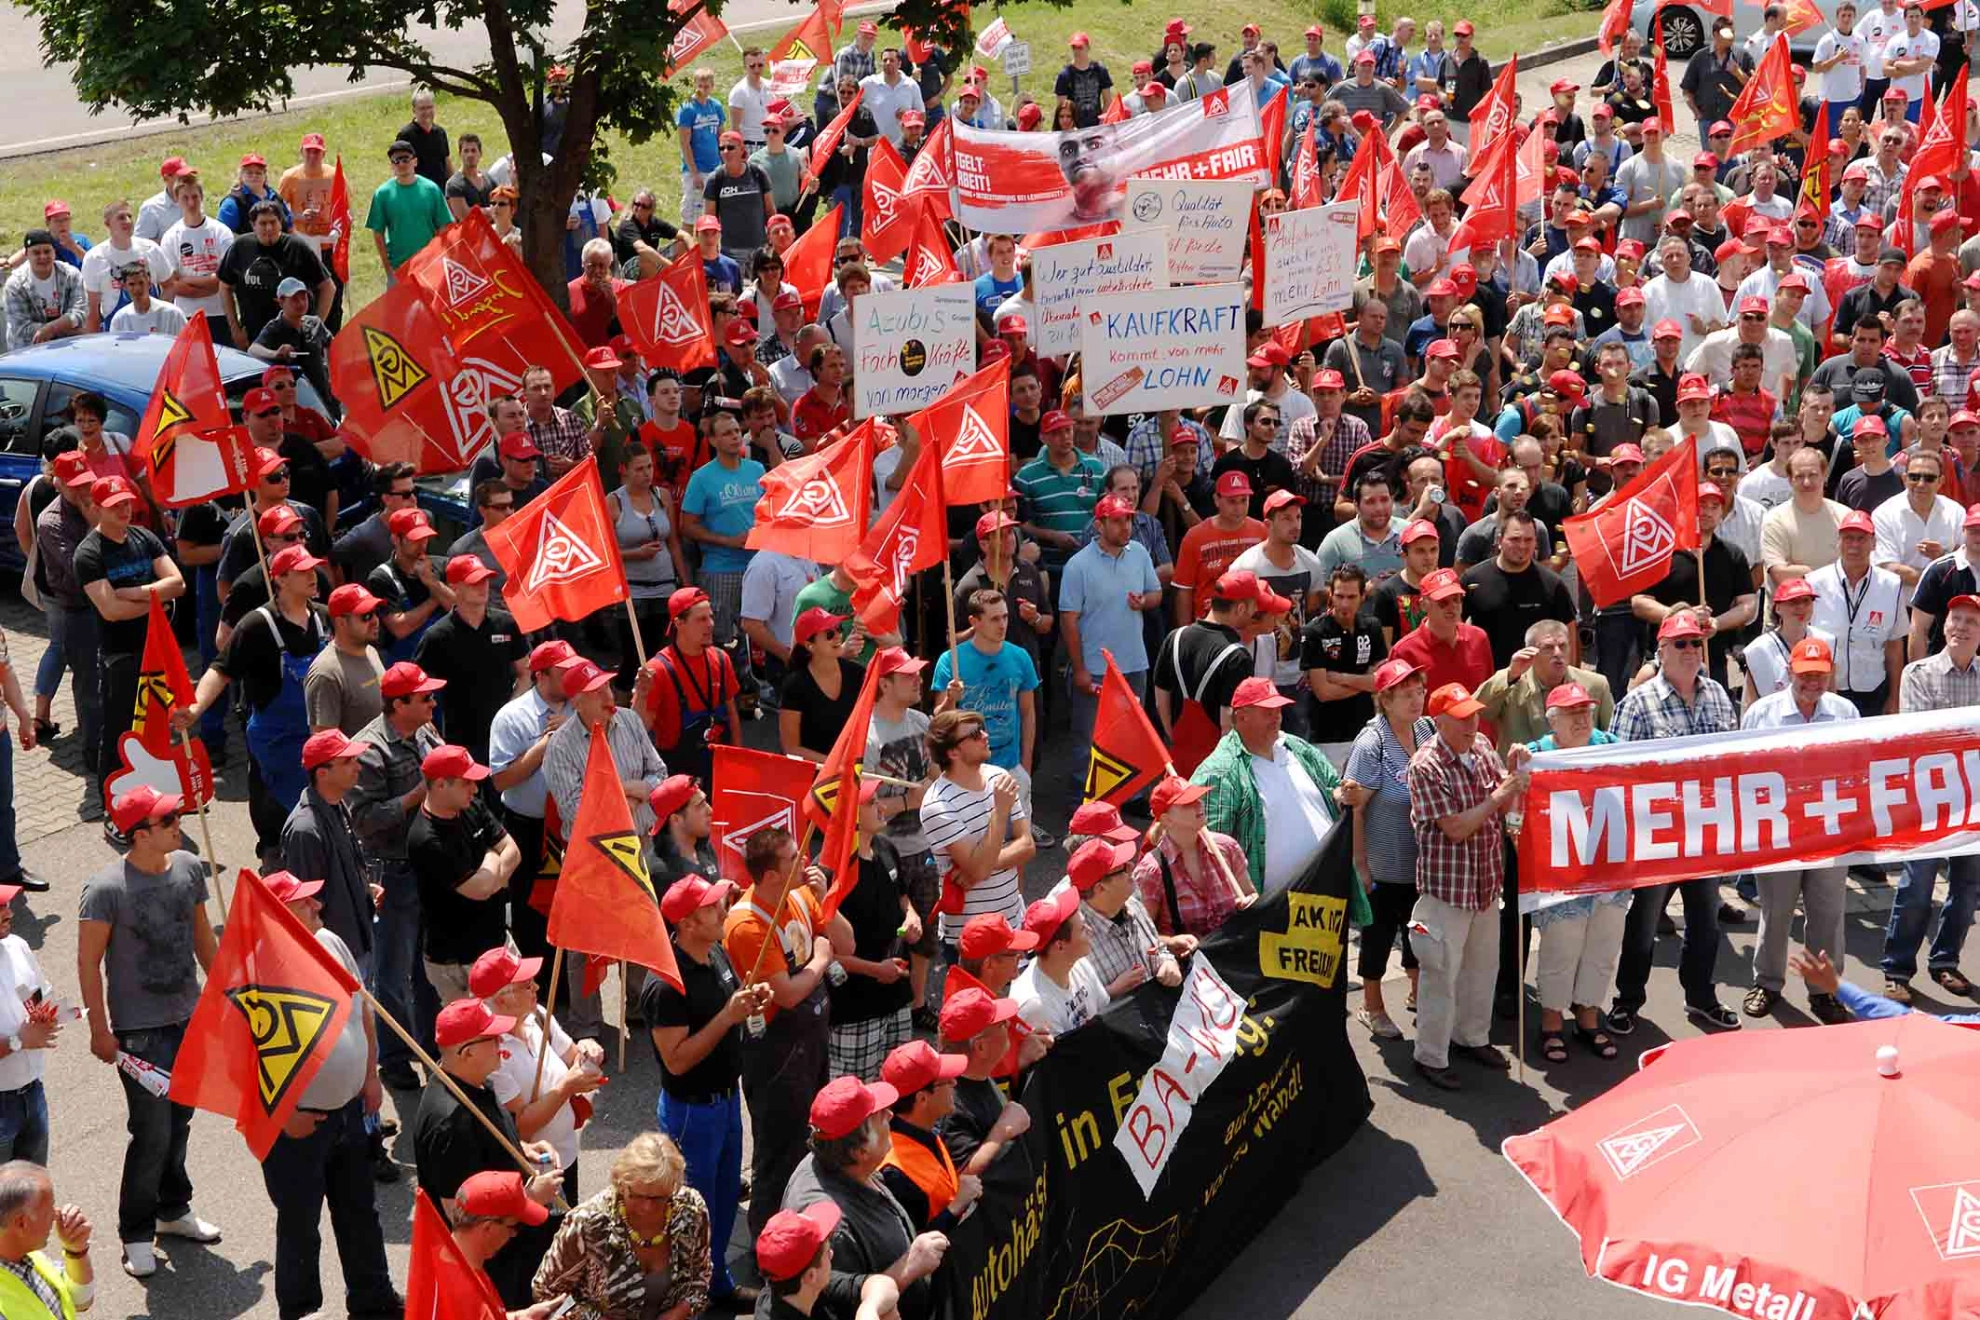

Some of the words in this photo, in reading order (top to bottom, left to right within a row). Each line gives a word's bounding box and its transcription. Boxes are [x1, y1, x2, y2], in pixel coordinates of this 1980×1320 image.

[1209, 146, 1256, 175] FAIR
[1108, 305, 1240, 338] KAUFKRAFT
[1168, 346, 1190, 358] von
[1194, 343, 1225, 356] mehr
[1144, 366, 1211, 390] LOHN
[867, 388, 891, 409] von
[895, 383, 947, 402] morgen
[1356, 635, 1371, 651] 82
[1550, 772, 1791, 868] MEHR
[1056, 1109, 1102, 1170] in
[1642, 1253, 1689, 1293] IG
[1699, 1264, 1816, 1320] Metall
